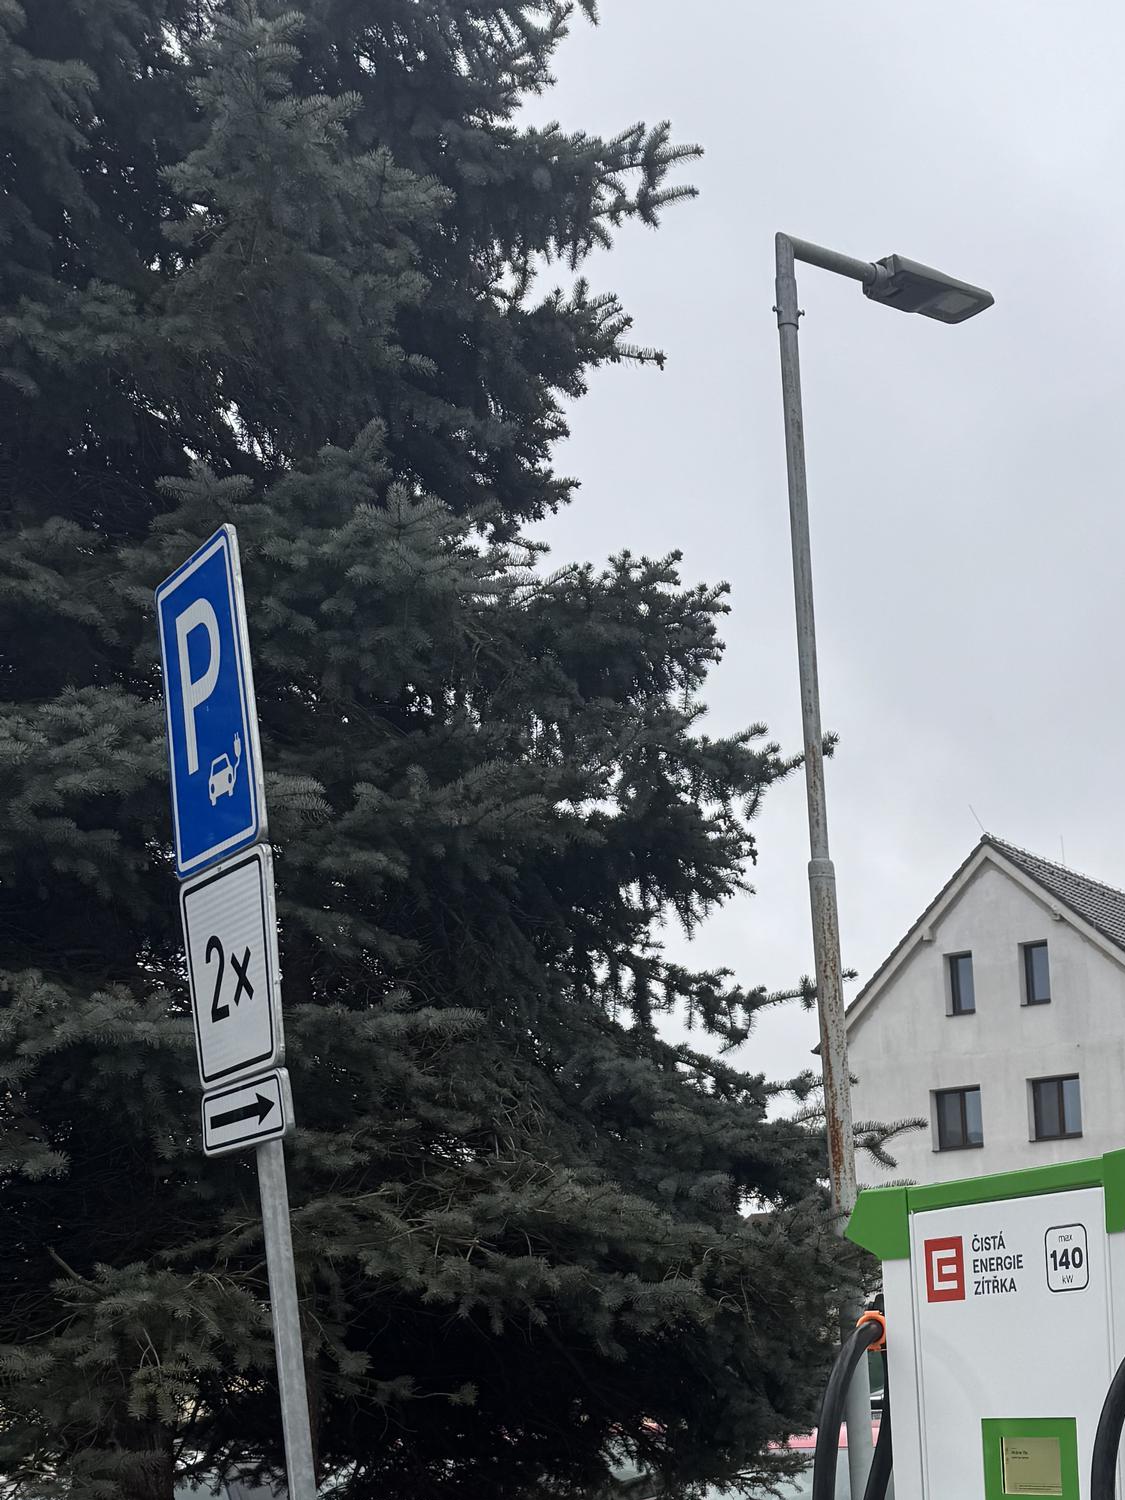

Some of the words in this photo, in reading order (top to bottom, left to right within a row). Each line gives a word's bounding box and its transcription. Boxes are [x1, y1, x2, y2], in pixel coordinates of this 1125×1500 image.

[175, 598, 220, 776] P
[204, 936, 254, 1024] 2x
[971, 1231, 1006, 1252] ČISTÁ
[1058, 1234, 1074, 1243] max
[973, 1254, 1024, 1274] ENERGIE
[1050, 1247, 1083, 1272] 140
[974, 1276, 1017, 1296] ZÍTŘKA
[1062, 1275, 1074, 1284] kW
